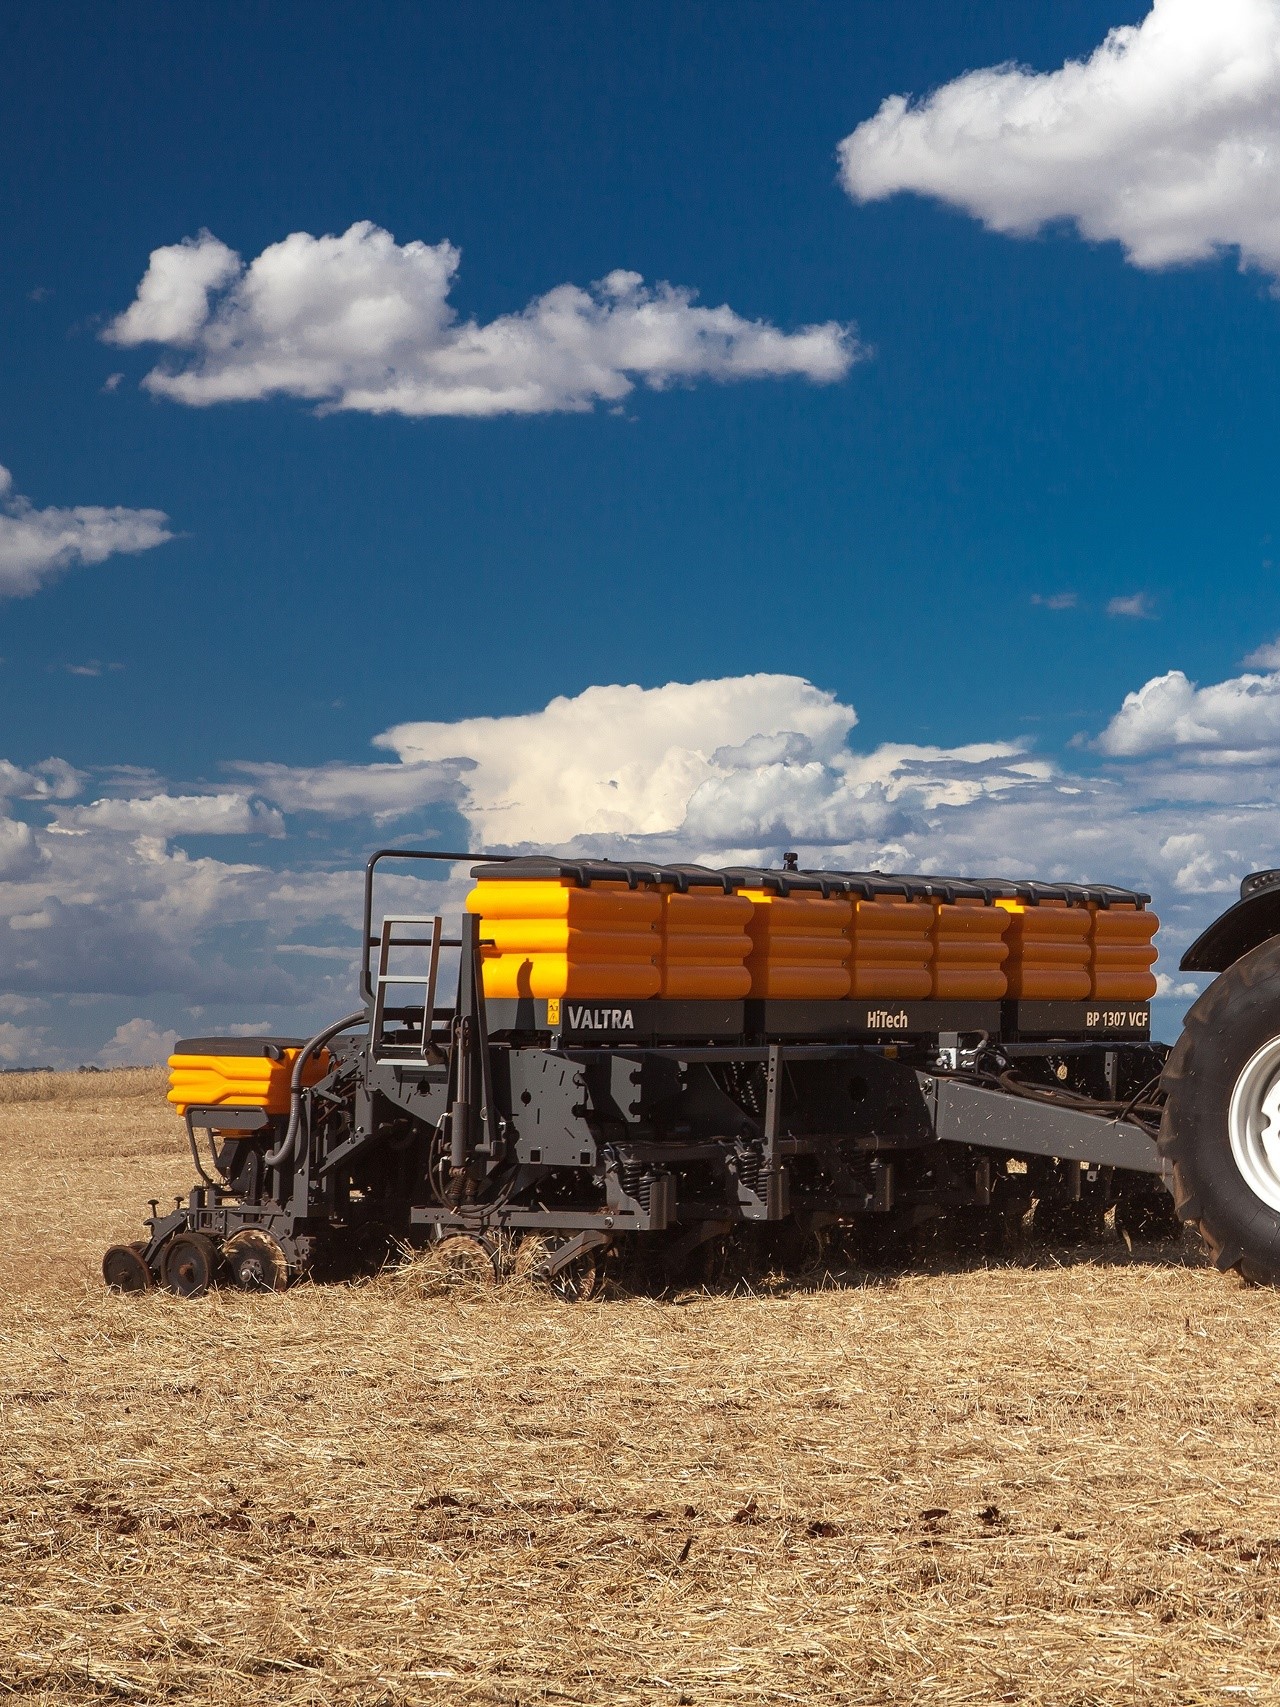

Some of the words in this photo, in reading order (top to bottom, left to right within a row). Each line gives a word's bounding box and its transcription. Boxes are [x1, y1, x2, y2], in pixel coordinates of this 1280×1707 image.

[568, 1006, 634, 1029] VALTRA
[867, 1010, 908, 1029] HiTech
[1086, 1012, 1099, 1027] BP
[1102, 1011, 1126, 1027] 1307
[1129, 1012, 1148, 1027] VCF
